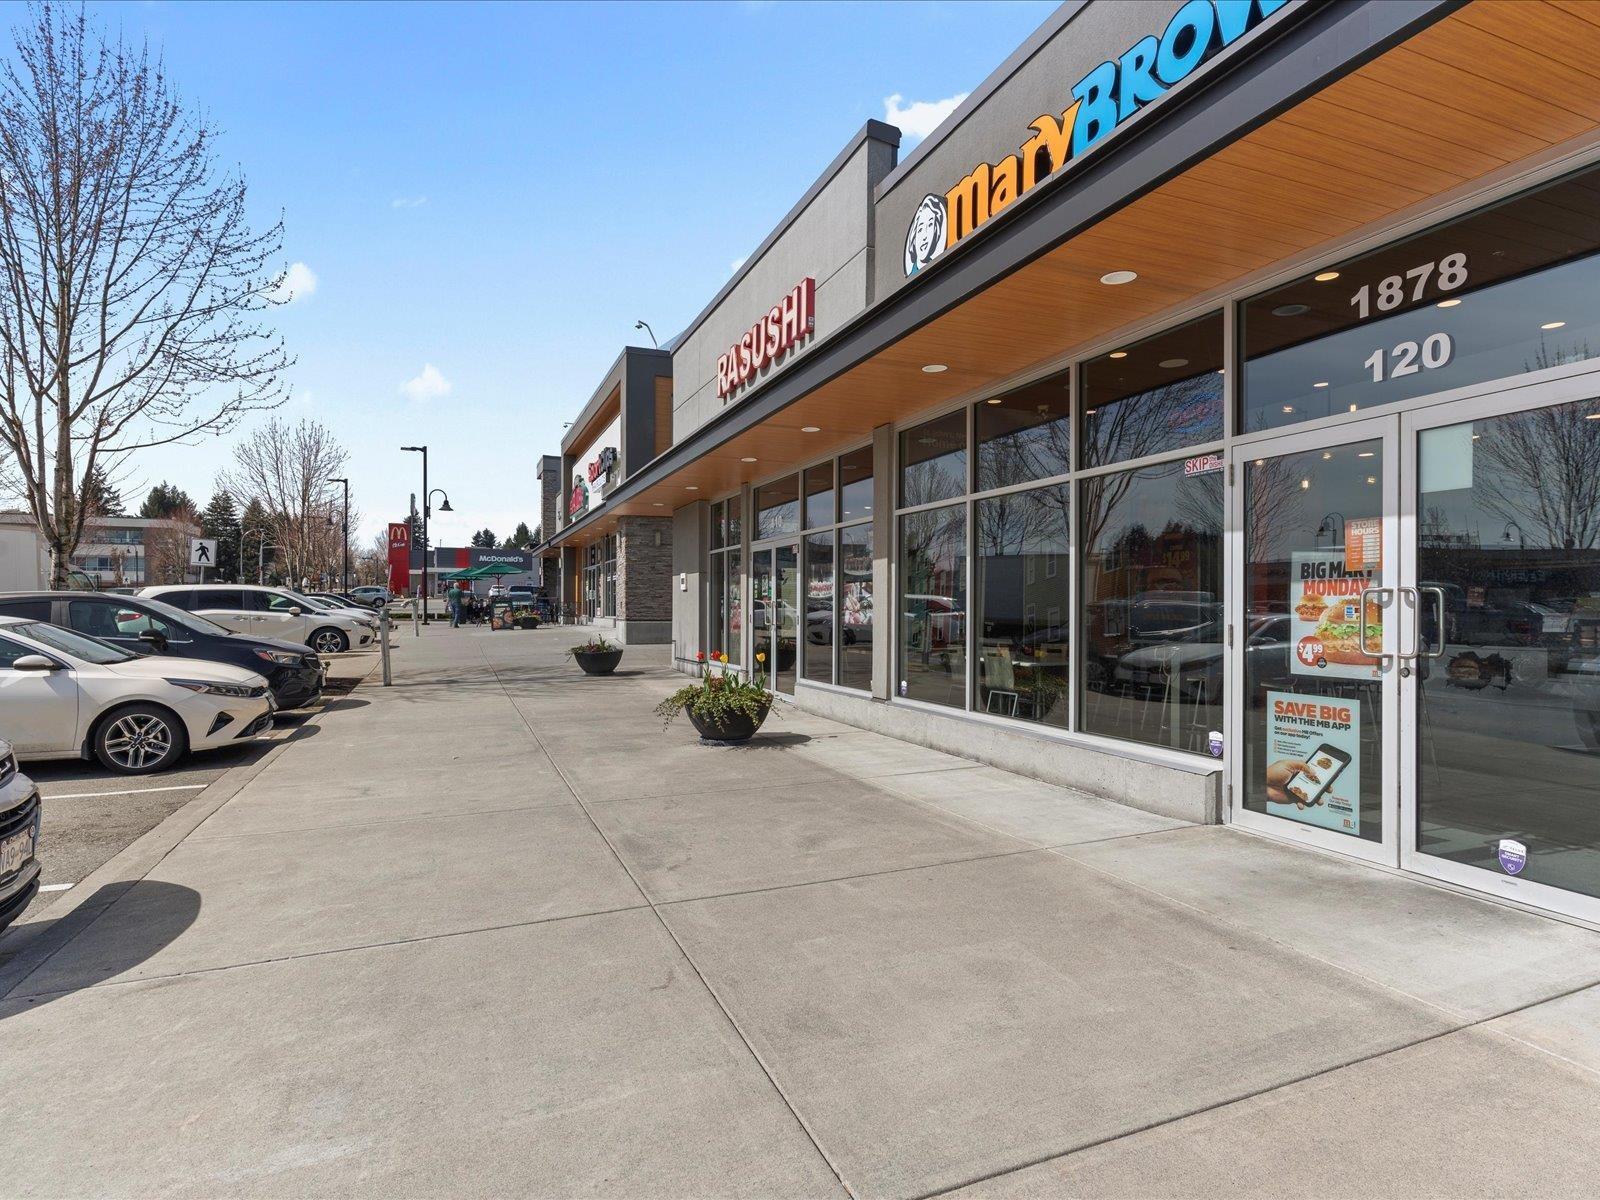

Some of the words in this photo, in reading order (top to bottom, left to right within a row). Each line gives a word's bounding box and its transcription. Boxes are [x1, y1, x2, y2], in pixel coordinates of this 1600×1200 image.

[945, 0, 1291, 250] maryBRO
[1350, 252, 1469, 319] 1878
[1364, 332, 1453, 383] 120
[1185, 457, 1208, 473] SKIP
[1352, 519, 1379, 528] STORE
[1352, 527, 1380, 536] HOURS
[479, 555, 523, 563] McDonald's
[1301, 562, 1326, 579] BIG
[1304, 579, 1370, 596] MONDAY
[1274, 700, 1317, 719] SAVE
[1320, 705, 1351, 723] BIG
[1274, 714, 1297, 725] WITH
[1298, 716, 1315, 727] THE
[1316, 719, 1330, 729] MB
[1331, 722, 1351, 731] APP
